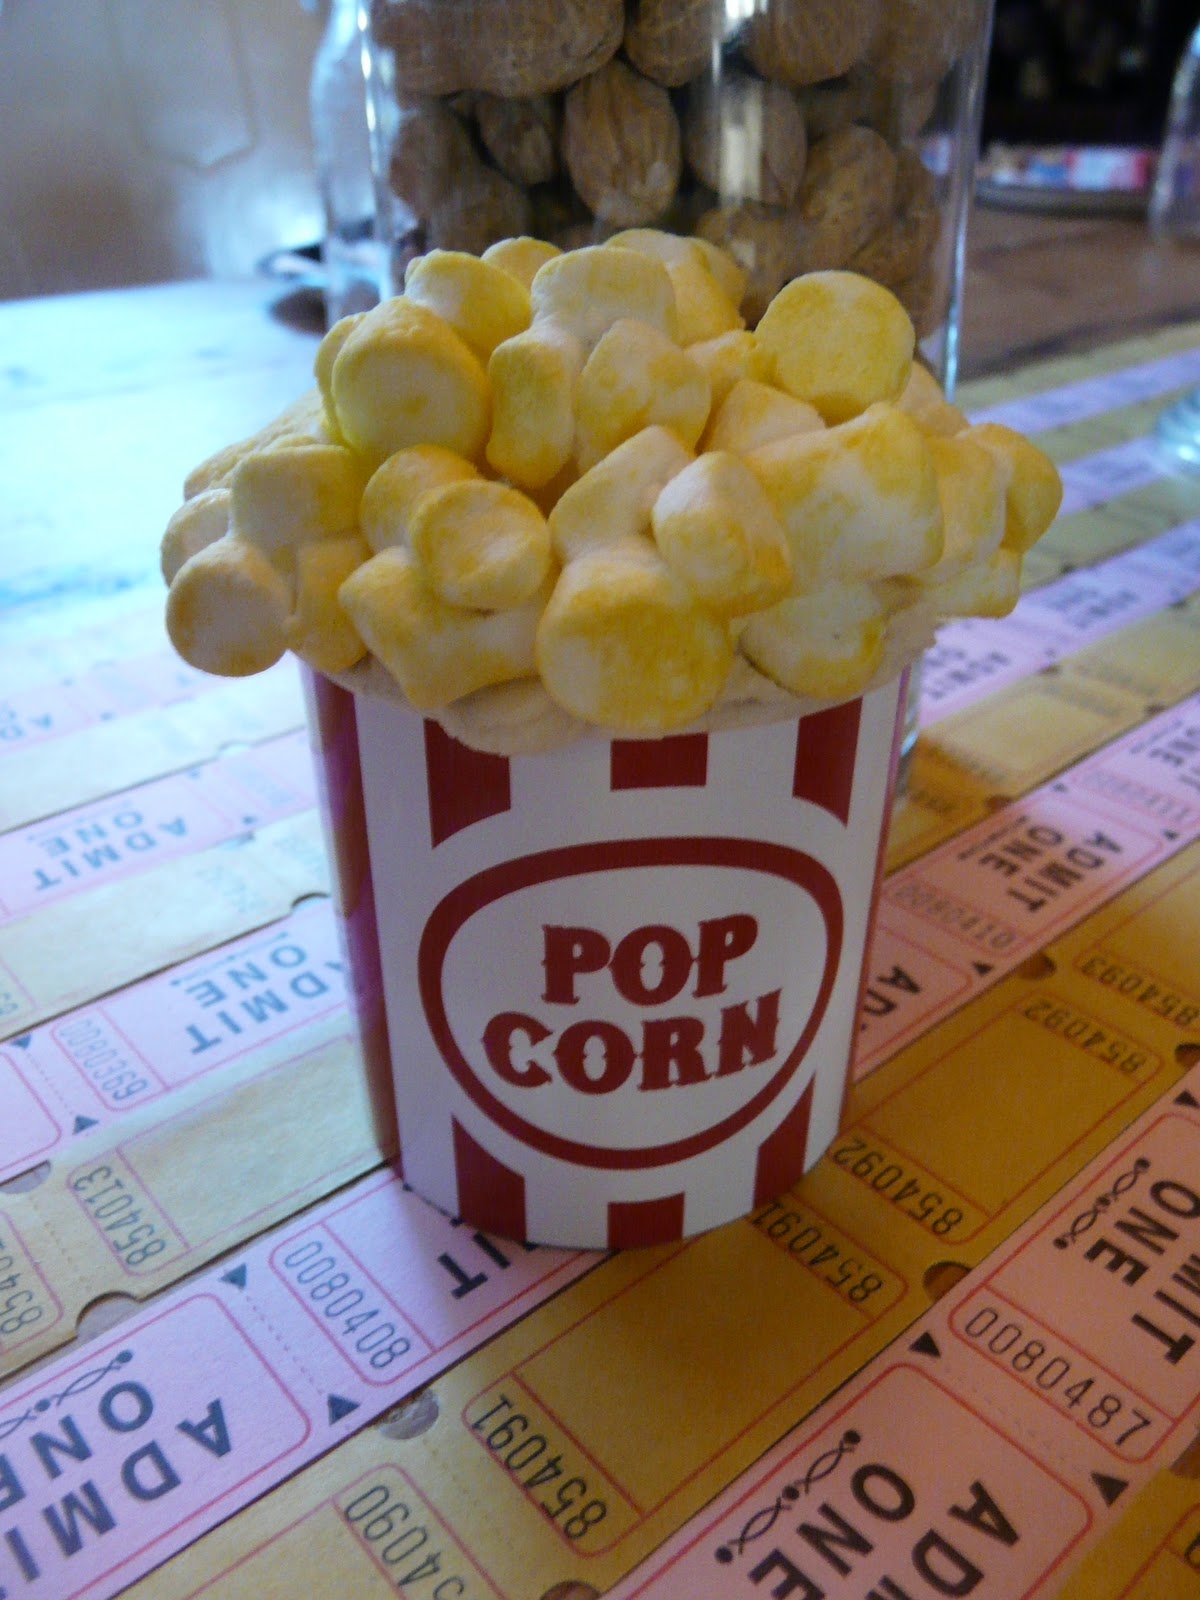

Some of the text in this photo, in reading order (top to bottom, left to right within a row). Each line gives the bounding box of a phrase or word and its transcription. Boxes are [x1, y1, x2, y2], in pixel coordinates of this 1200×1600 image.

[33, 816, 188, 891] ADMIT
[979, 825, 1063, 877] ONE
[1008, 831, 1122, 912] ADMIT
[186, 943, 308, 1009] ONE
[541, 912, 759, 1006] POP
[481, 987, 783, 1096] CORN
[73, 1164, 167, 1267] 854013
[832, 1137, 964, 1236] 854092
[1083, 1180, 1200, 1289] ONE
[752, 1199, 884, 1303] 854091
[284, 1240, 412, 1370] 0080408
[964, 1306, 1152, 1448] 0080487
[0, 1398, 232, 1600] ADMI
[471, 1393, 608, 1540] 854091
